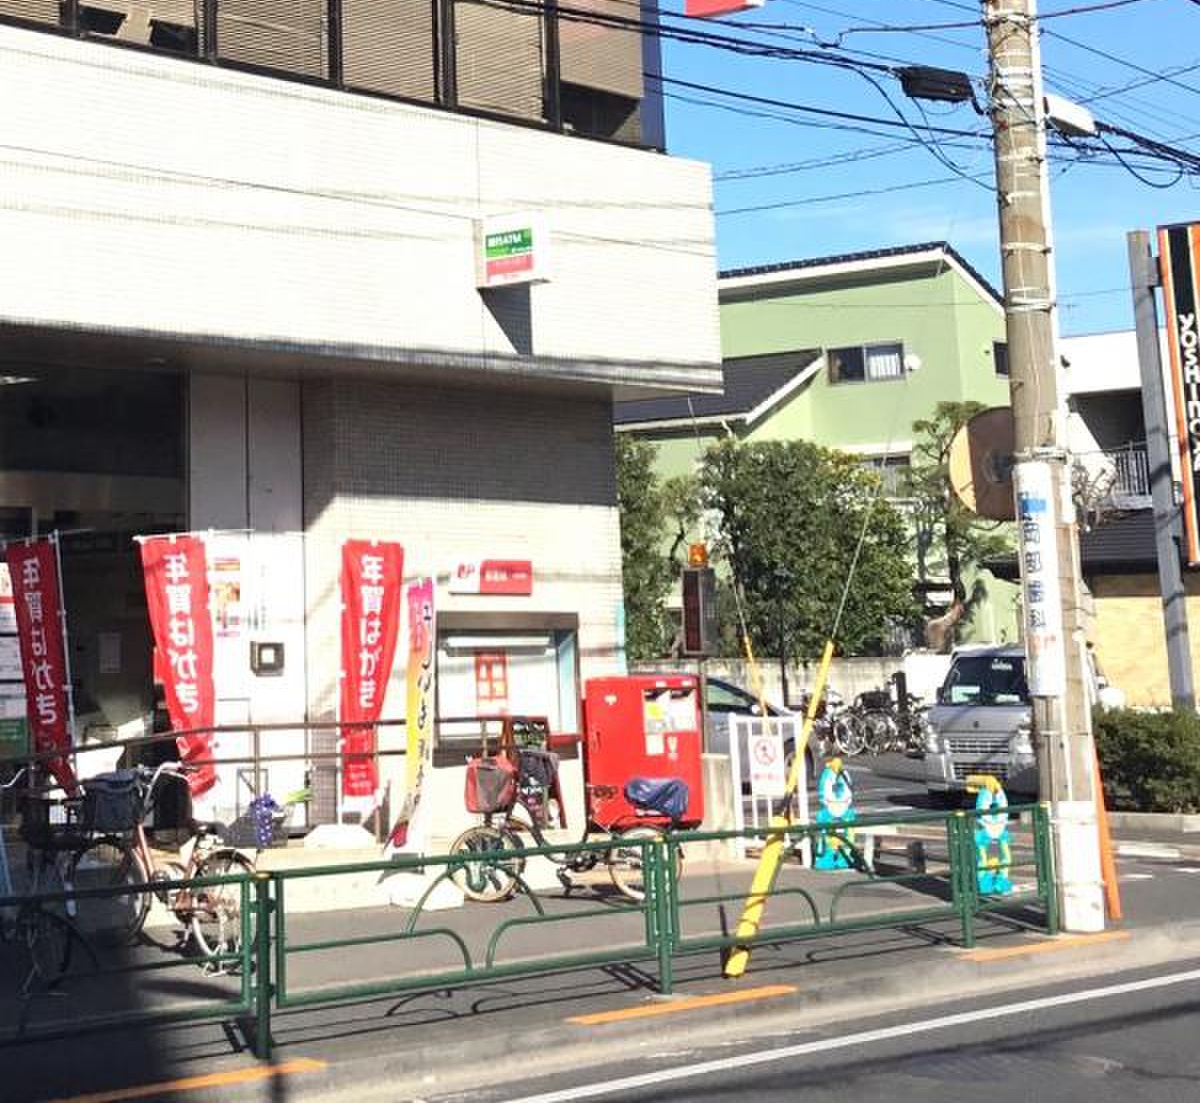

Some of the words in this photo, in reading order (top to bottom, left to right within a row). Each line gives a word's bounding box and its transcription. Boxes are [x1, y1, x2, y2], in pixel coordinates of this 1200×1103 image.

[359, 553, 385, 709] 年賀はがき
